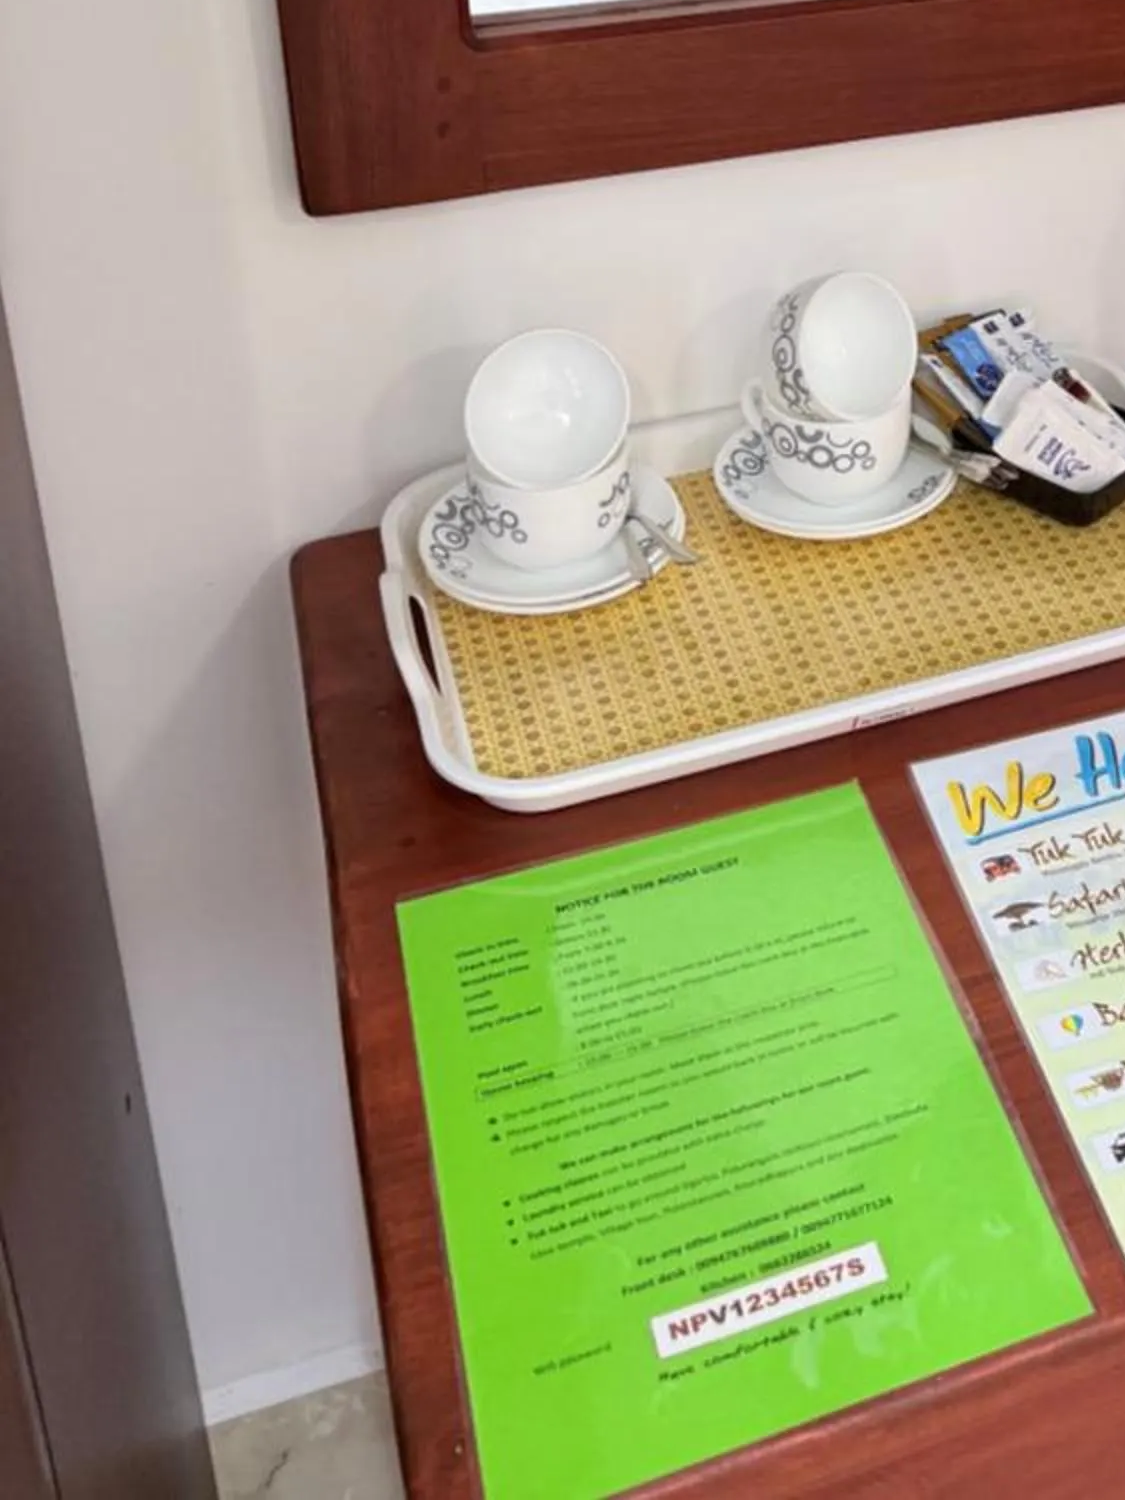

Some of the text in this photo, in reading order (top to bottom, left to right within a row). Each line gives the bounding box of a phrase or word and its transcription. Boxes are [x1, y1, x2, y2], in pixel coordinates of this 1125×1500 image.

[946, 761, 1059, 837] We
[1018, 837, 1076, 865] Tuk
[668, 1257, 866, 1341] NPV1234567S
